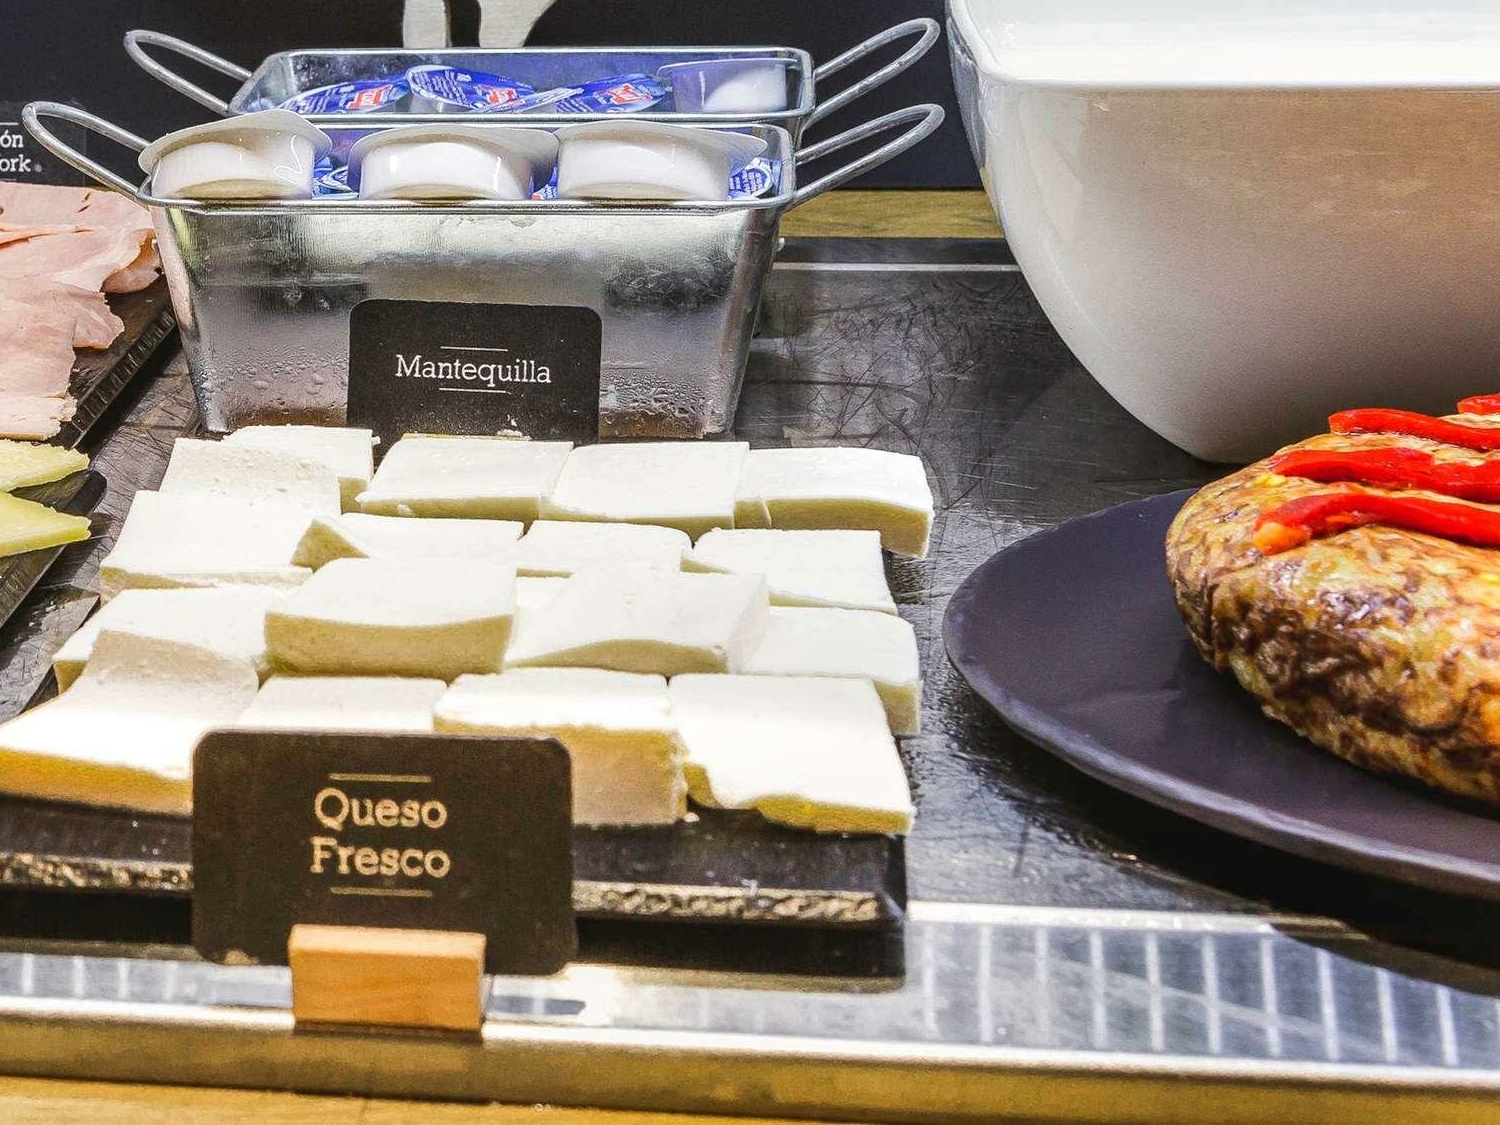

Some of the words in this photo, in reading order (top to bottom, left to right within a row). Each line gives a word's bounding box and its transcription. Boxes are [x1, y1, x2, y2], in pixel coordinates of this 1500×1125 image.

[395, 354, 552, 387] Mantequilla
[313, 787, 448, 832] Queso
[310, 835, 451, 878] Fresco
